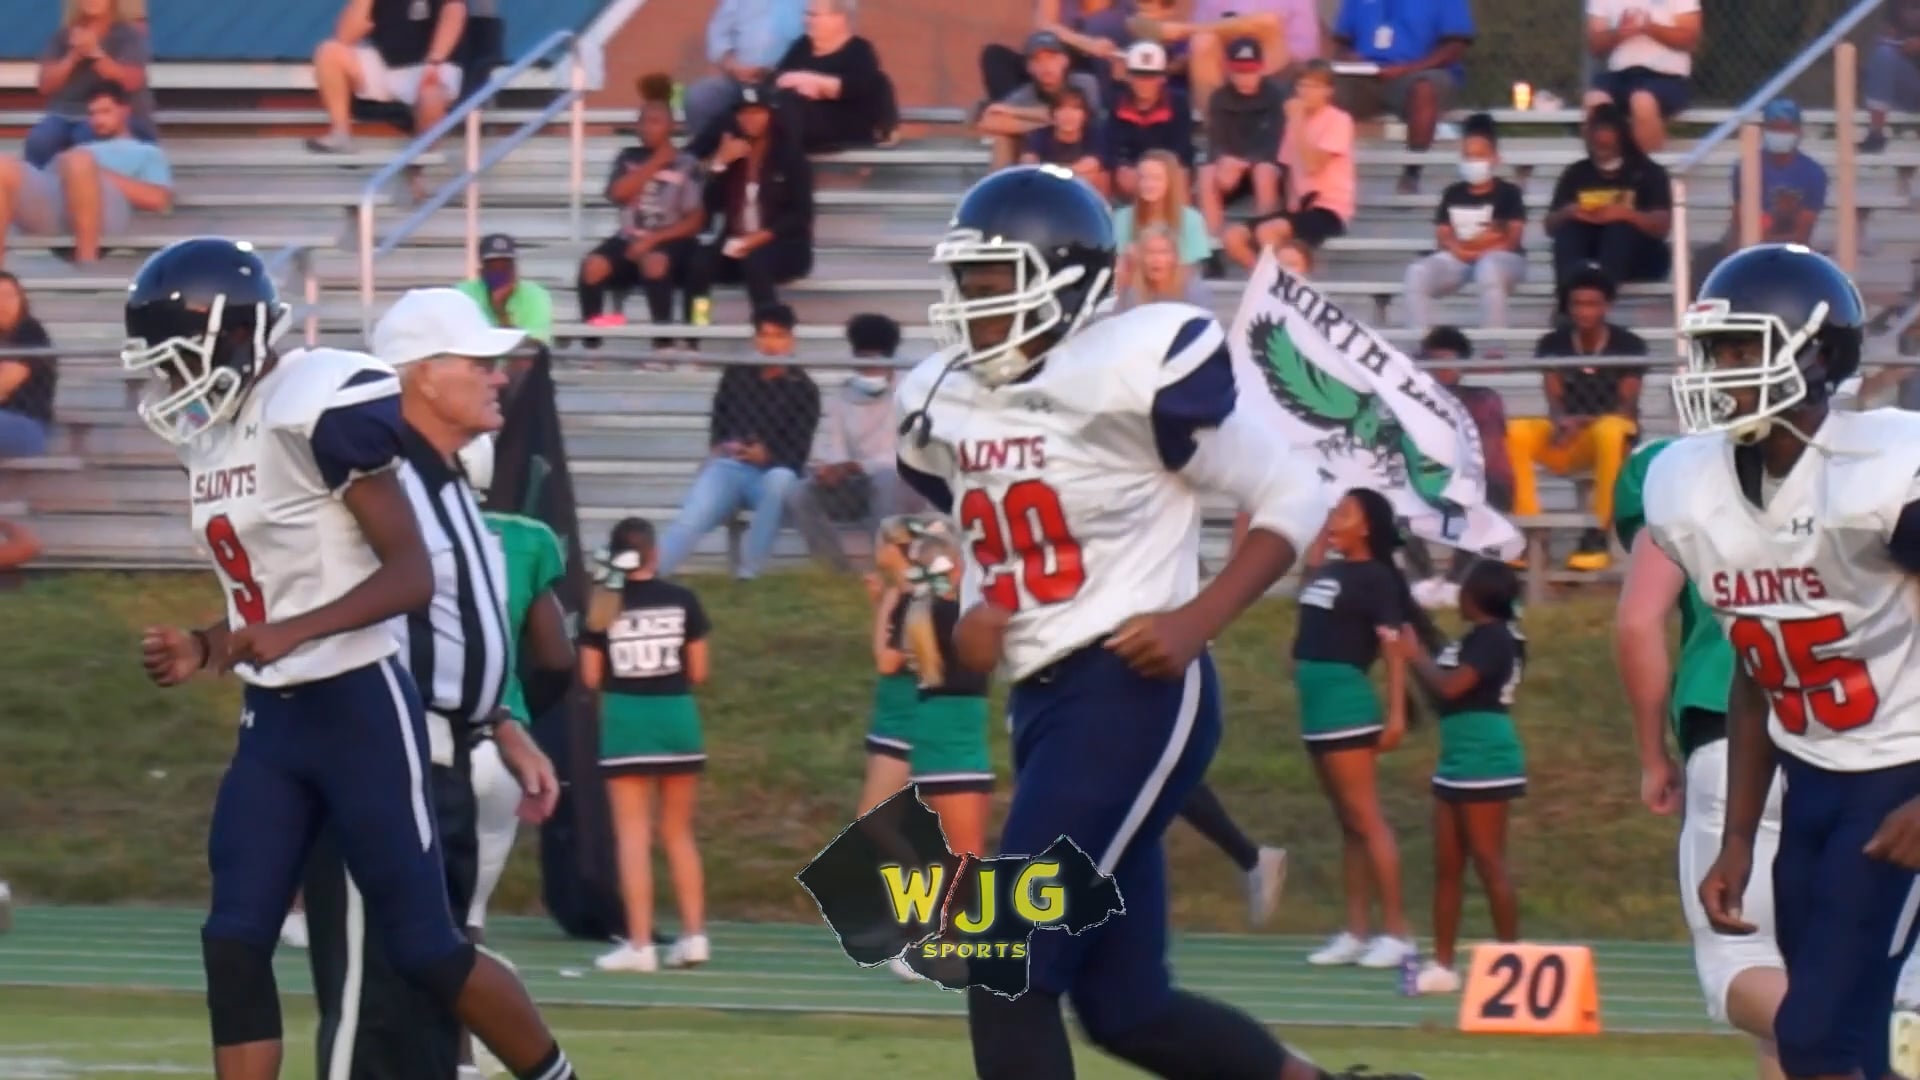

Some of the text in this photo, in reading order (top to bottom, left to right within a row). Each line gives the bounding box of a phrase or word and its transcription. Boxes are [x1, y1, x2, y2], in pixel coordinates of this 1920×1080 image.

[959, 435, 1047, 474] AINTS
[193, 463, 257, 504] SAINTS
[961, 478, 1087, 614] 20
[205, 513, 266, 626] 9
[1712, 565, 1828, 608] SAINTS
[609, 638, 685, 677] OUT
[1479, 952, 1567, 1020] 20
